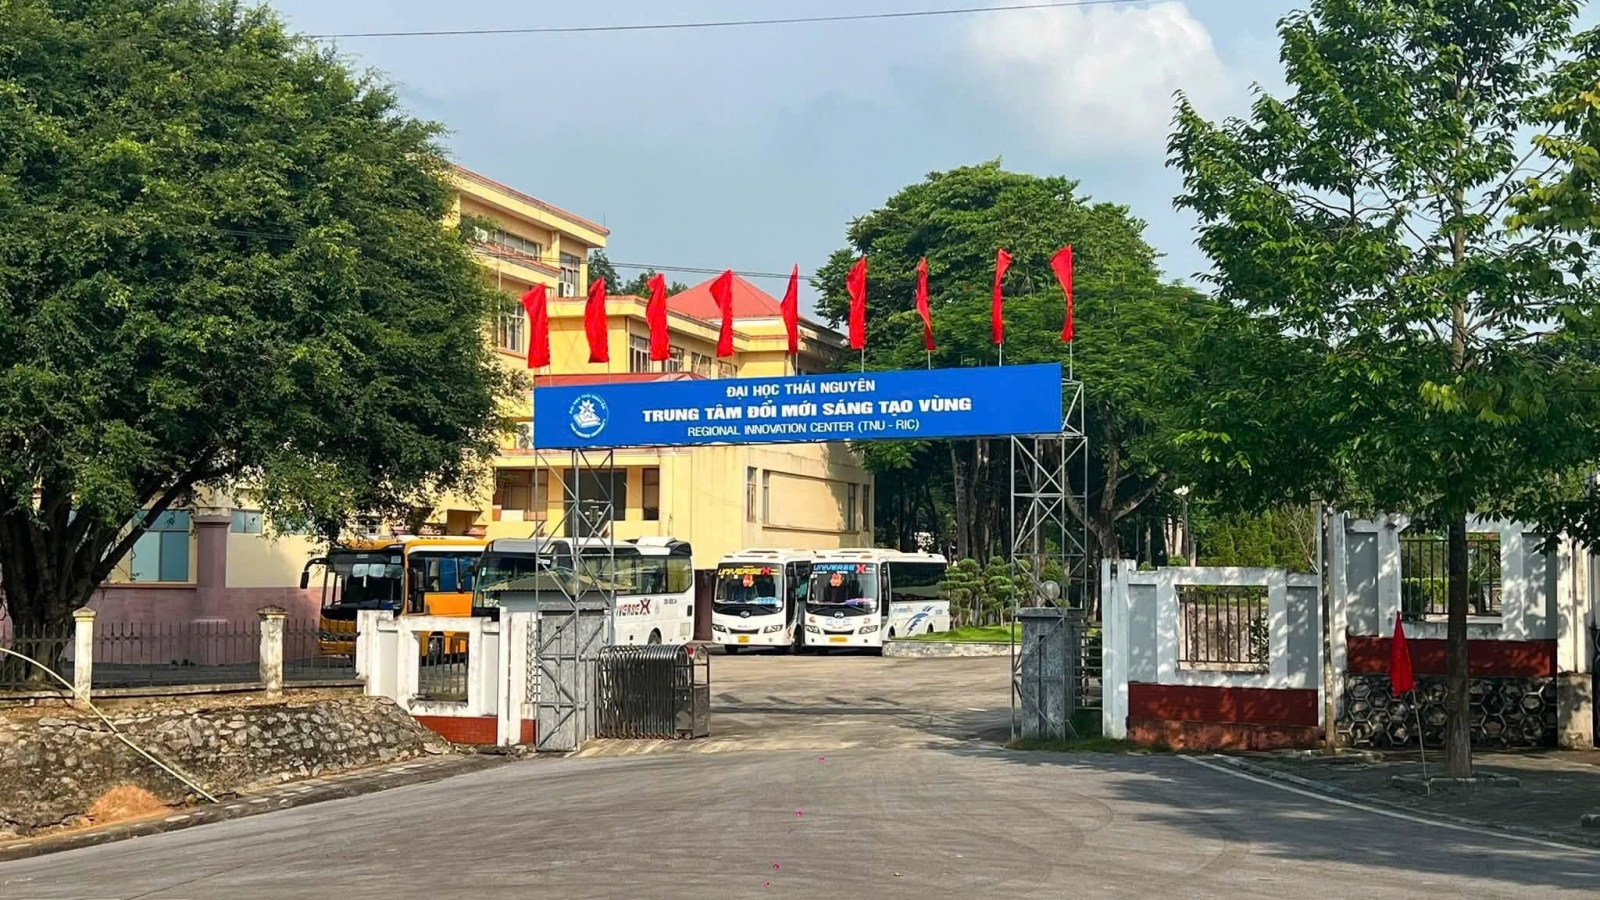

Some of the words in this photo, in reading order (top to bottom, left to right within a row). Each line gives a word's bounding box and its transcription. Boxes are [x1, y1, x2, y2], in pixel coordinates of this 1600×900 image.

[726, 386, 748, 400] ĐẠI
[753, 384, 779, 400] HỌC
[785, 379, 815, 394] THÁI
[820, 377, 875, 393] NGUYÊN
[643, 408, 699, 422] TRUNG
[705, 404, 742, 420] TÂM
[747, 399, 777, 418] ĐỔI
[781, 400, 817, 417] MỚI
[822, 399, 873, 416] SÁNG
[878, 399, 913, 417] TẠO
[919, 394, 972, 412] VÙNG
[687, 425, 740, 437] REGIONAL
[744, 422, 806, 436] INNOVATION
[810, 421, 854, 433] CENTER
[858, 420, 885, 433] (TNU
[895, 418, 920, 432] RIC)
